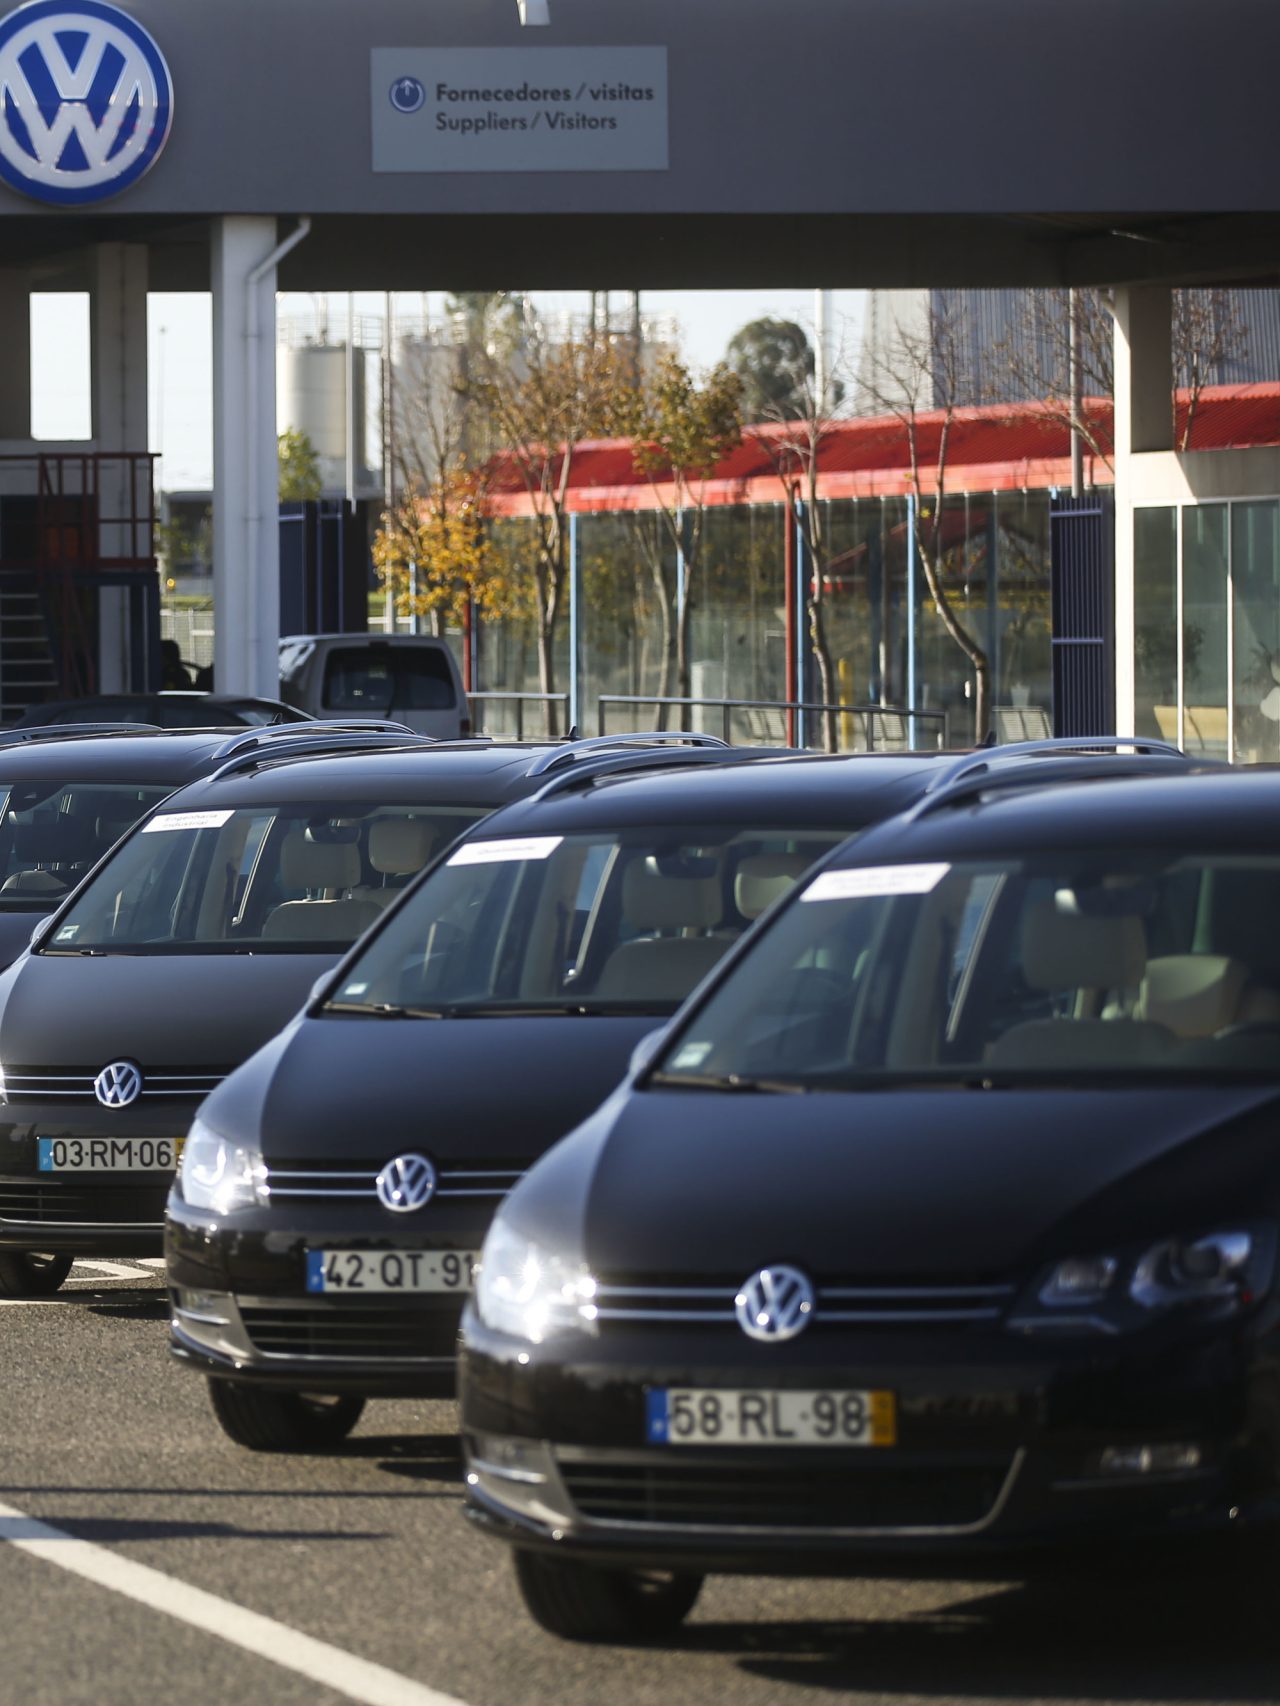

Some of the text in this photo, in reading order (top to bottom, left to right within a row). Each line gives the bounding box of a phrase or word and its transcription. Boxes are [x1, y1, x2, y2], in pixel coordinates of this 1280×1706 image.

[436, 82, 572, 102] Fornecedores
[589, 83, 654, 101] visitas
[436, 112, 528, 135] Suppliers
[544, 111, 617, 130] Visitors
